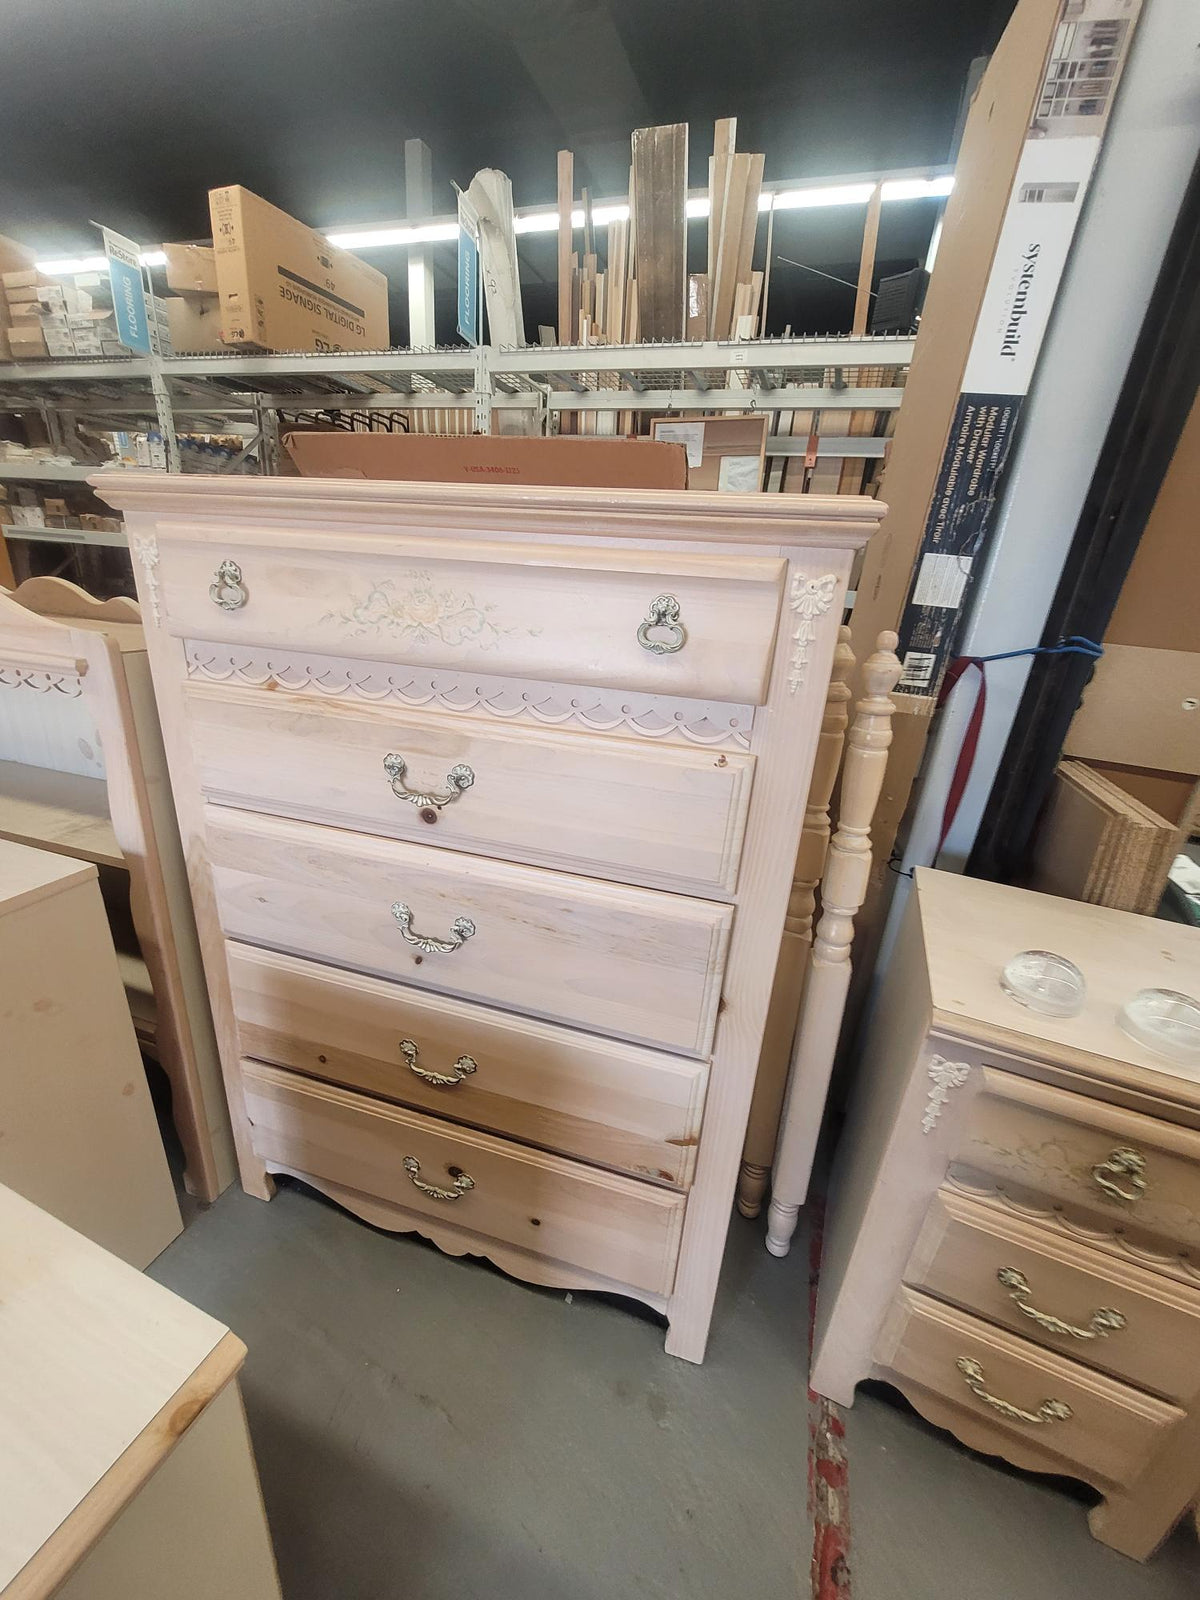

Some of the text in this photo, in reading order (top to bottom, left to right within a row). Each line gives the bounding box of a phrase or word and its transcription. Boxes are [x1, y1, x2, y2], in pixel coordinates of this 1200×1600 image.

[123, 276, 139, 339] FLOORING
[278, 285, 322, 315] SIGNAGE
[463, 250, 472, 326] FLOORING
[1000, 243, 1041, 357] systembuild
[323, 308, 355, 332] DIGITAL
[355, 324, 366, 337] LG
[958, 405, 976, 444] Armoire
[966, 405, 988, 464] with Drawer
[944, 445, 965, 496] Modulable
[967, 406, 999, 496] Modular Wardrobe
[938, 497, 950, 519] avec
[932, 520, 945, 544] Tiroir
